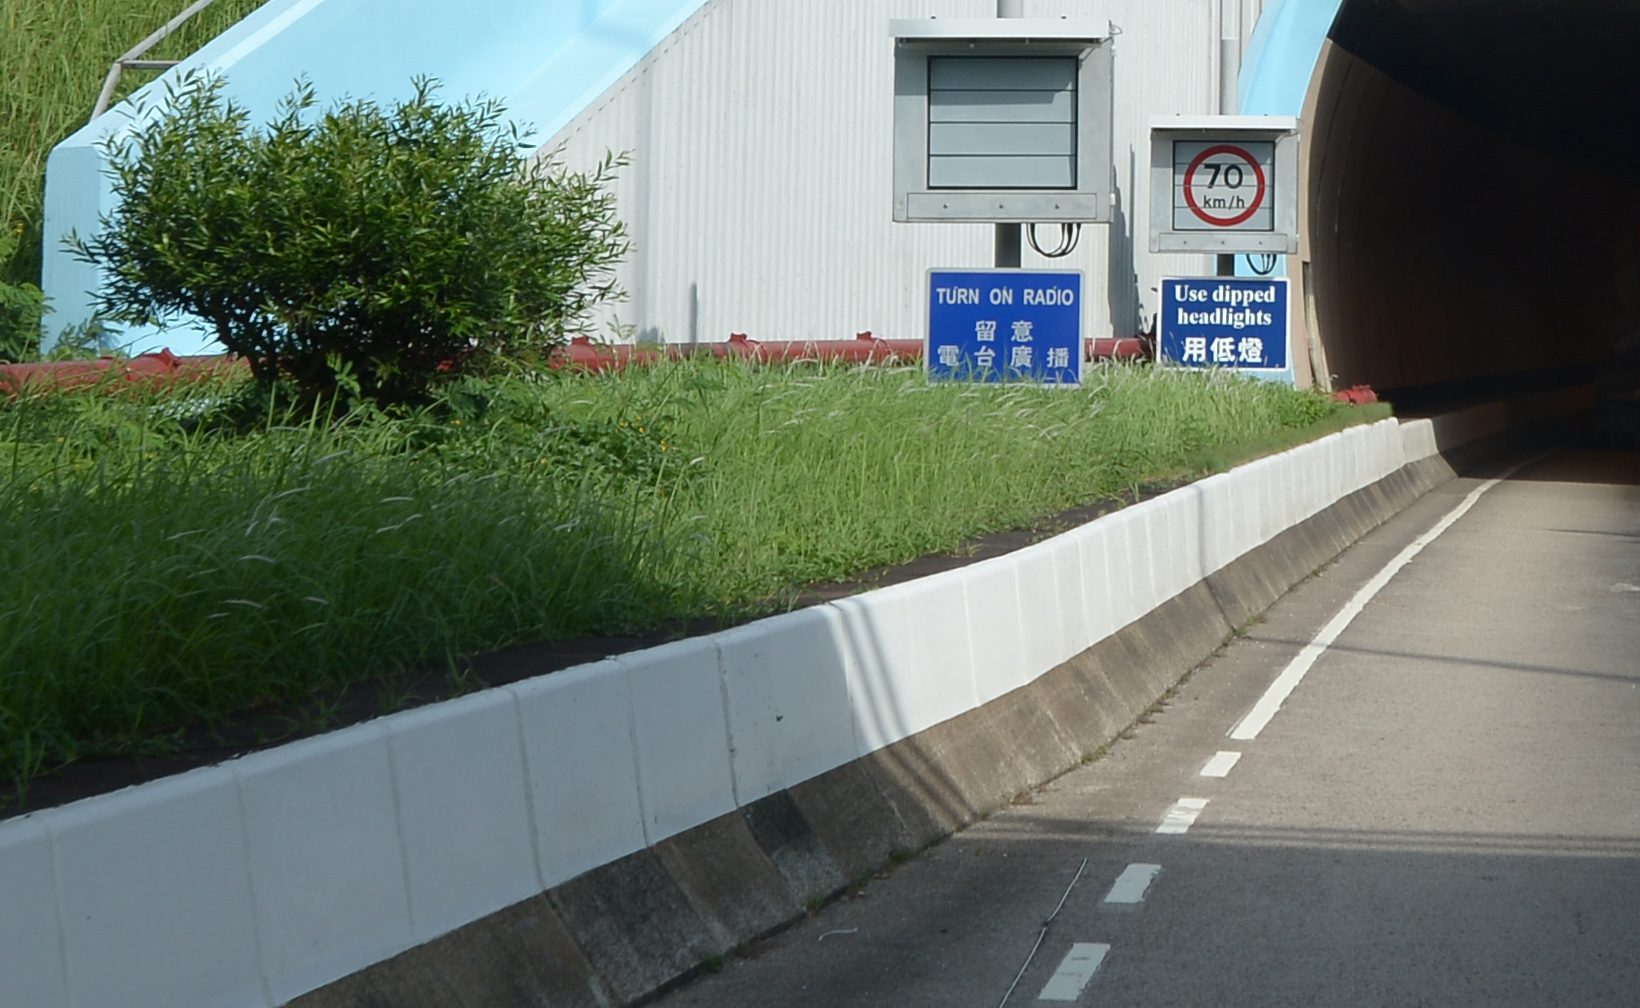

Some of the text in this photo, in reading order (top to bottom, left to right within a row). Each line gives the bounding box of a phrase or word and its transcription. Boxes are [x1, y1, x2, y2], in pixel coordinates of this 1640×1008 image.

[1204, 163, 1243, 189] 70
[1203, 195, 1245, 210] km/h
[936, 288, 1074, 306] TURN ON RADIO
[1174, 284, 1276, 307] Use dipped
[1177, 307, 1273, 329] headlights
[975, 320, 1033, 342] 留意
[937, 345, 1069, 368] 電台廣播
[1182, 337, 1264, 363] 用低燈
